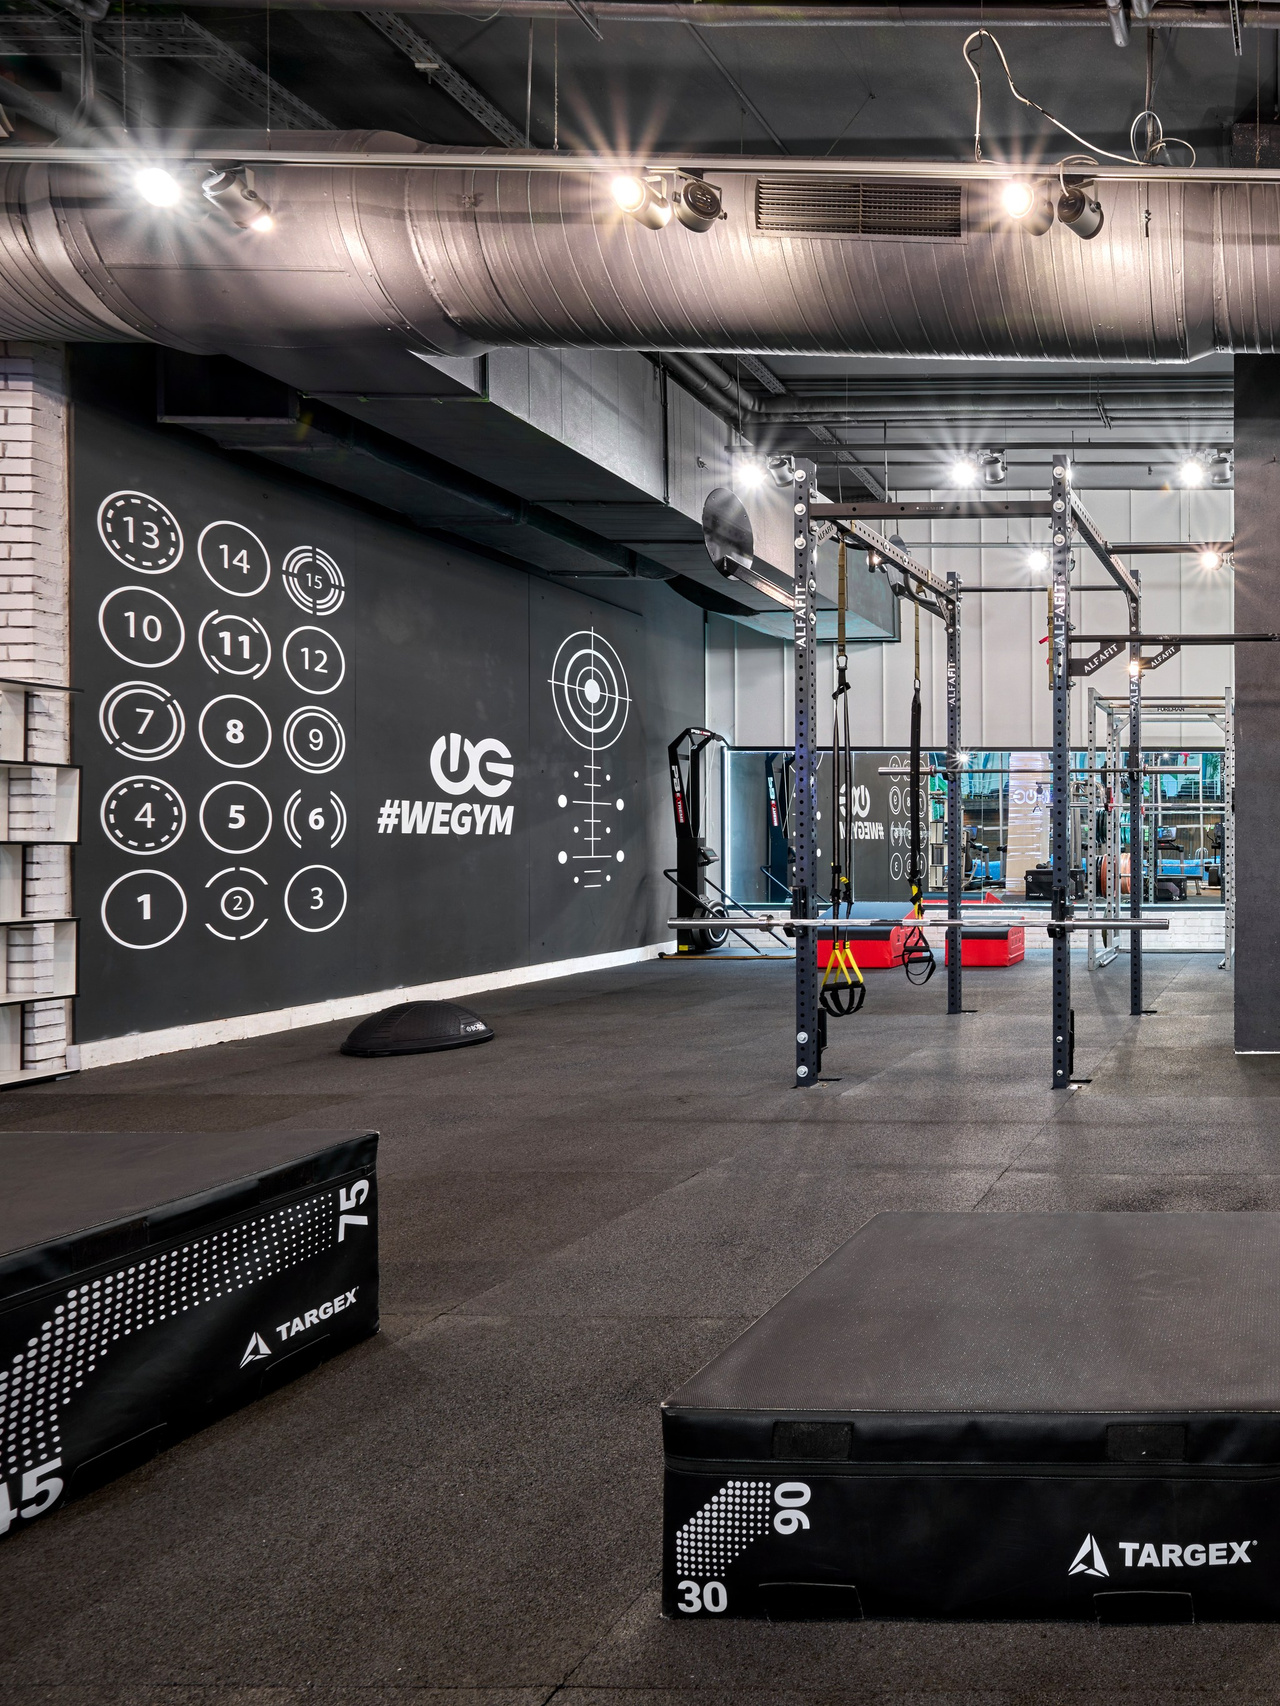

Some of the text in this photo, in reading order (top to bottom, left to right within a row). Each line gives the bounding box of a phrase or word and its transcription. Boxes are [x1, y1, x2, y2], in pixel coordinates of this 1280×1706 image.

[122, 516, 160, 550] 13
[218, 543, 251, 575] 14
[305, 572, 323, 590] 15
[123, 611, 163, 643] 10
[795, 585, 807, 648] ALFAFIT
[1054, 583, 1066, 648] ALFAFIT
[217, 630, 251, 660] 11
[1084, 643, 1118, 673] ALFAFIT
[1151, 646, 1176, 668] ALFAFIT
[300, 647, 329, 674] 12
[947, 660, 957, 706] ALFAFIT
[135, 708, 154, 735] 7
[225, 719, 245, 744] 8
[308, 728, 324, 751] 9
[134, 802, 156, 829] 4
[228, 804, 246, 829] 5
[309, 807, 324, 831] 6
[377, 799, 515, 836] #WEGYM
[137, 893, 151, 920] 1
[232, 895, 243, 911] 2
[309, 886, 324, 910] 3
[337, 1179, 370, 1243] 75
[277, 1288, 358, 1341] TARGEX
[774, 1482, 811, 1535] 90
[1119, 1541, 1253, 1567] TARGEX
[677, 1581, 728, 1613] 30
